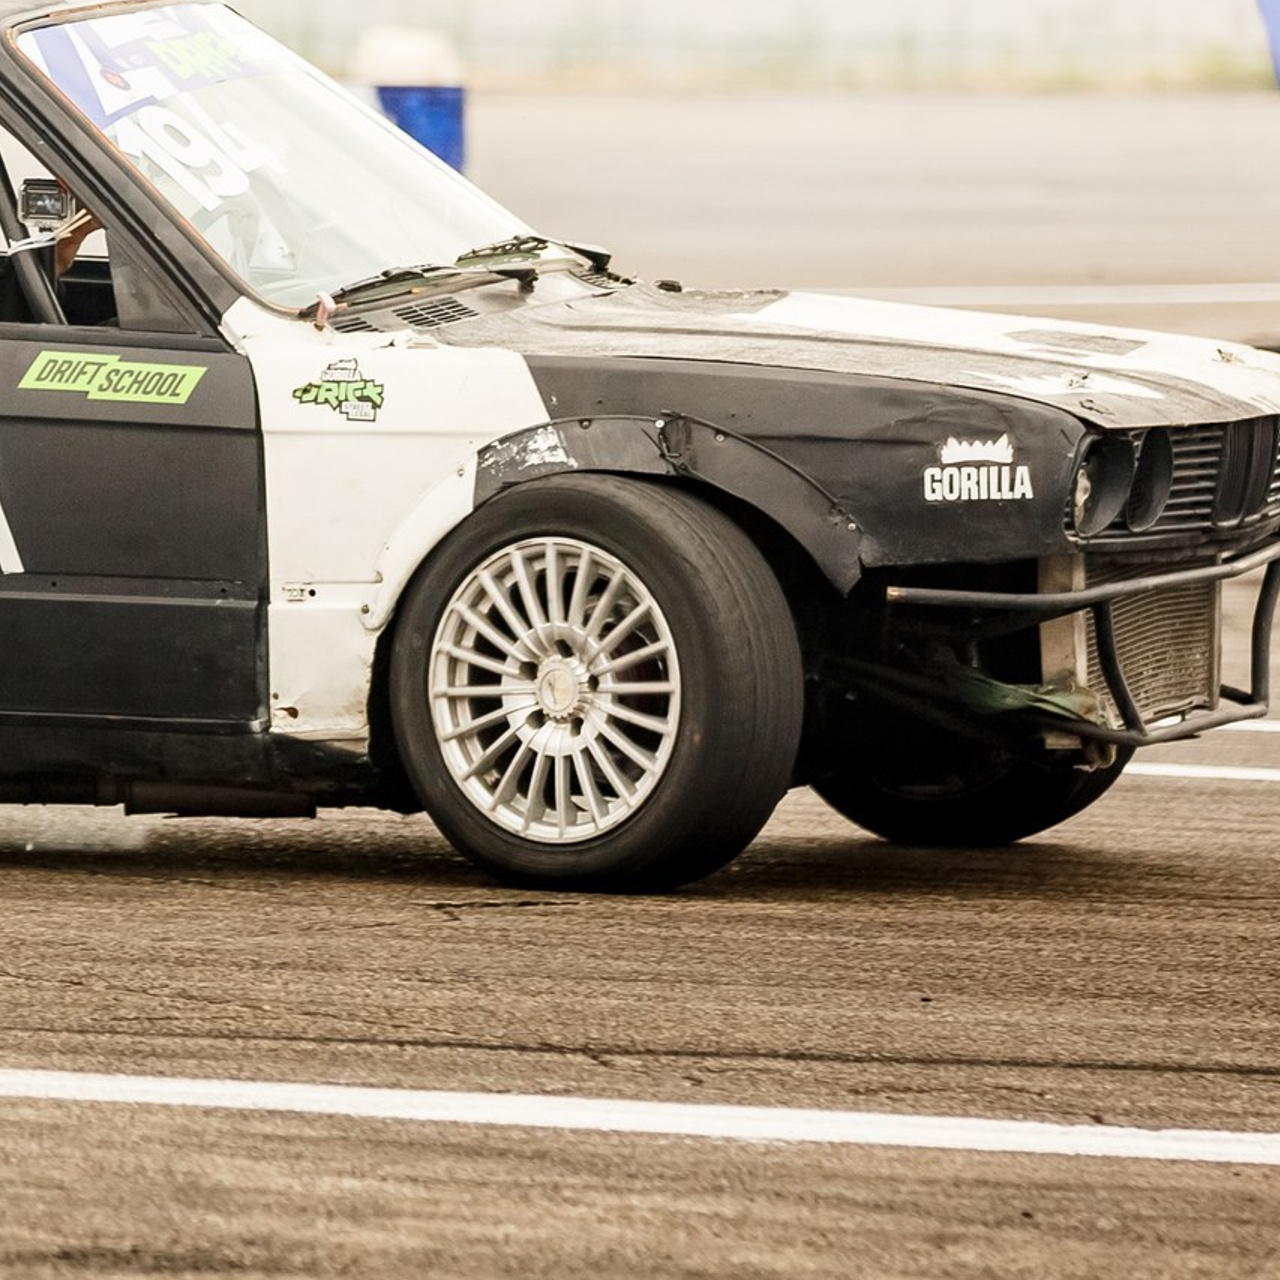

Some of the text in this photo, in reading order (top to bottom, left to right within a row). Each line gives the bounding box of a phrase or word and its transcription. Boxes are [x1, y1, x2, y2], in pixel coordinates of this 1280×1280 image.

[35, 359, 187, 397] DRIFT SCHOOL
[923, 465, 1034, 502] GORILLA
